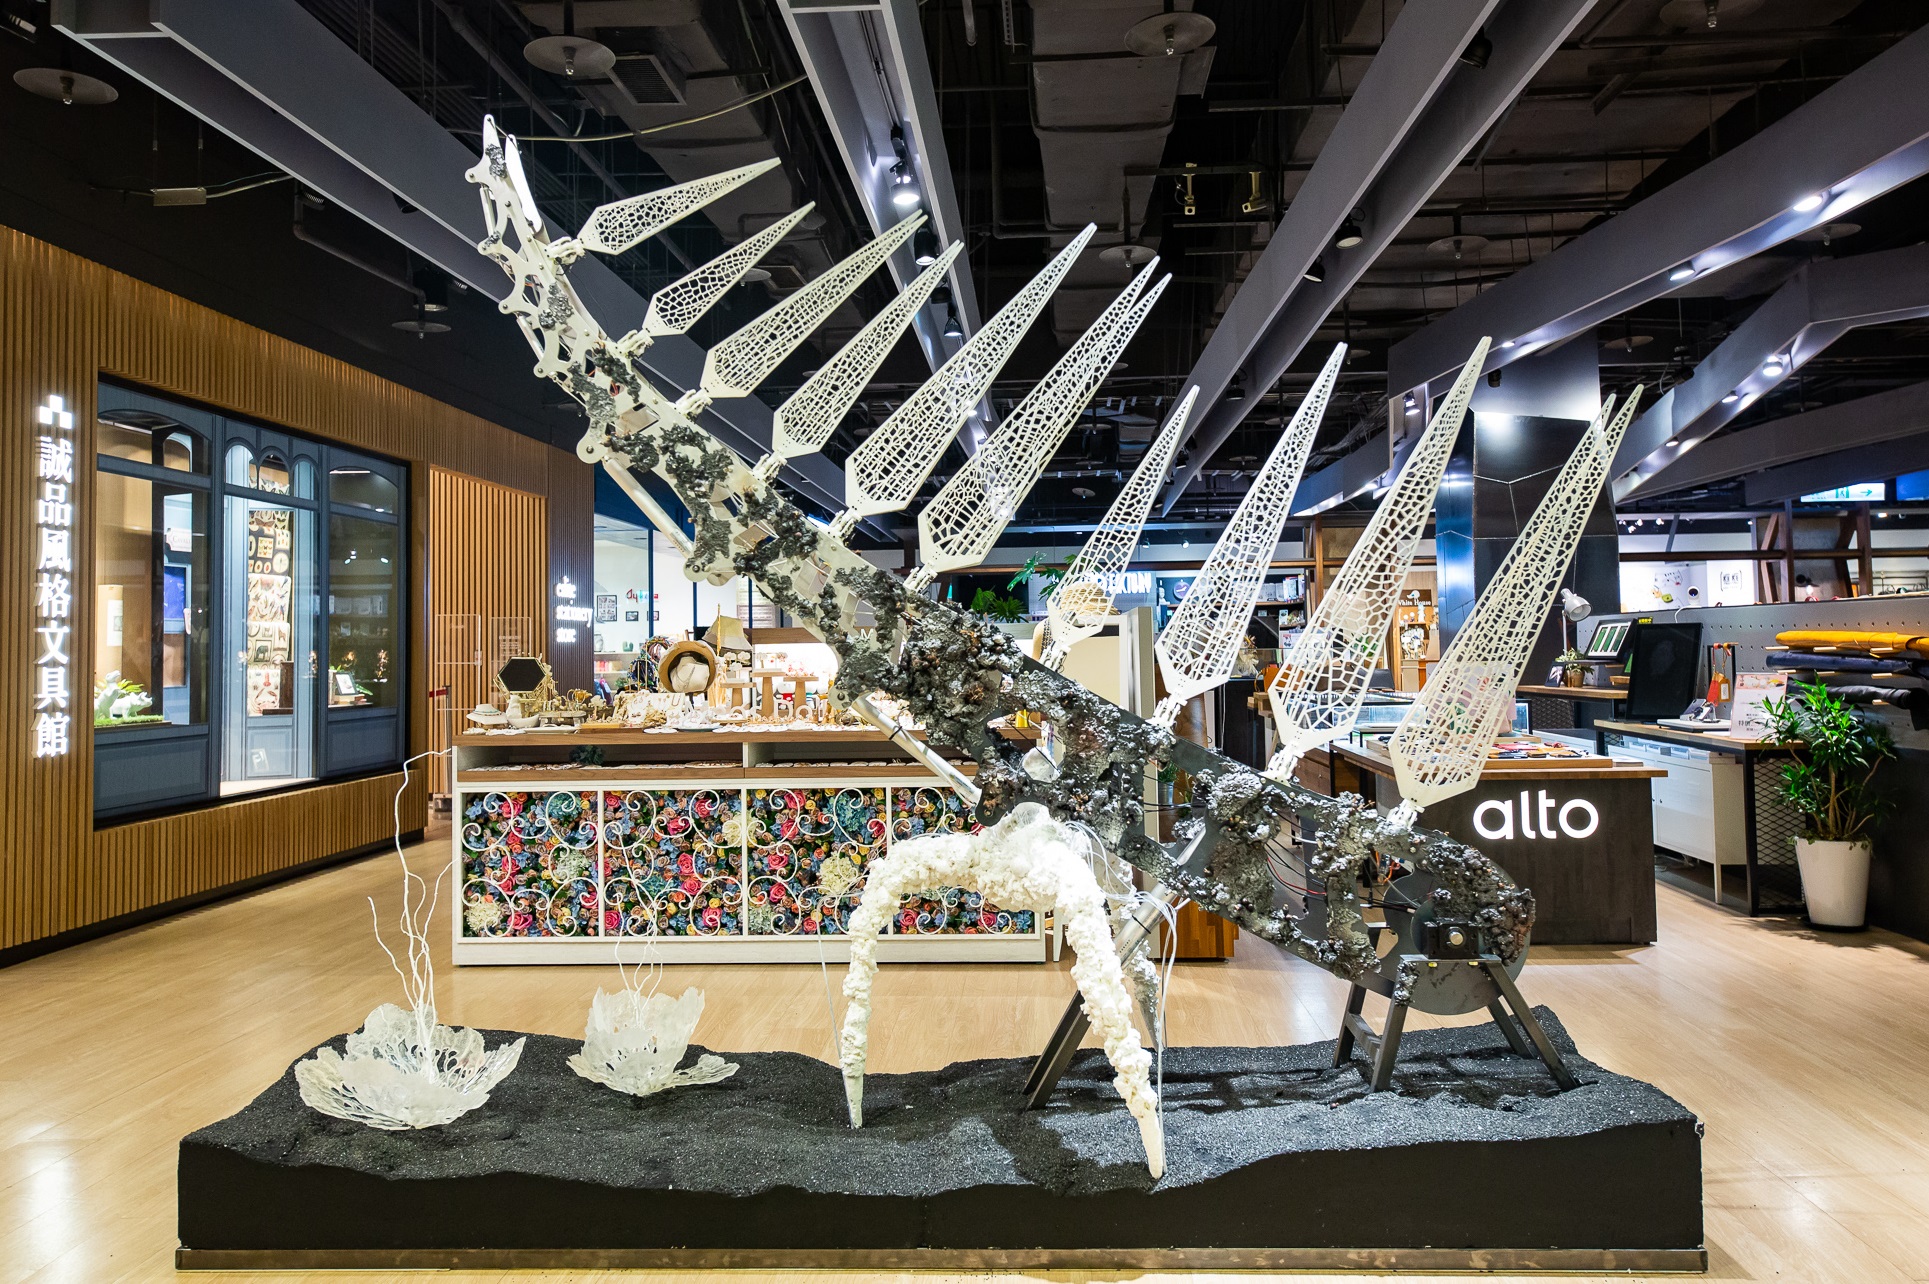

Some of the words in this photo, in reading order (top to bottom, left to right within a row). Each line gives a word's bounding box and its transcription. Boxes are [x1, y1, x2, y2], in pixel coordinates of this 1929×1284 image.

[36, 436, 72, 758] 誠品風格文具館
[1472, 789, 1599, 840] alto
